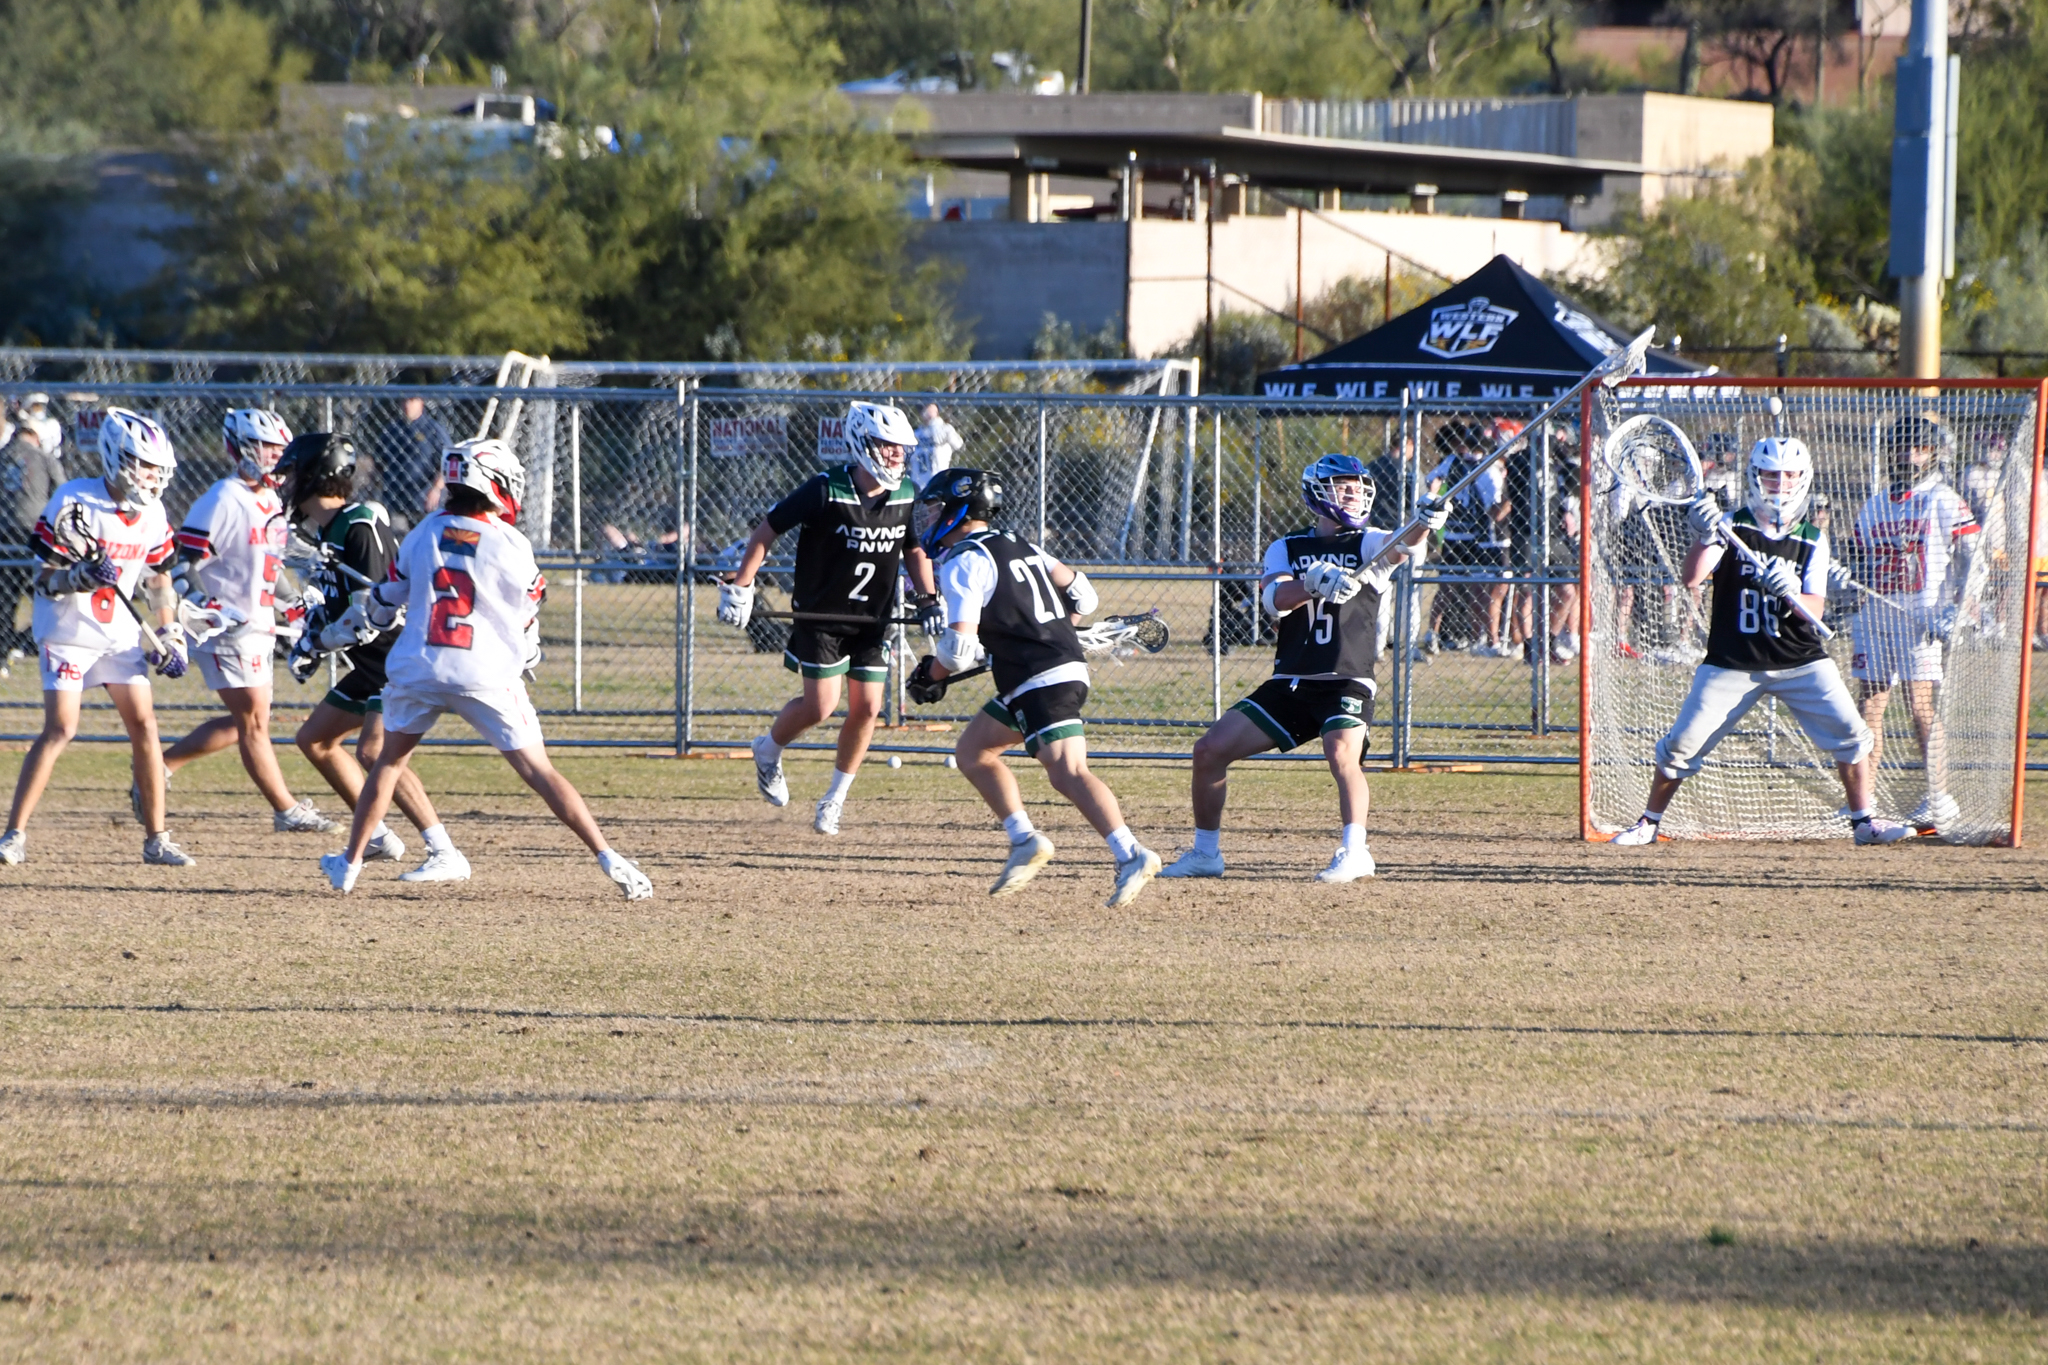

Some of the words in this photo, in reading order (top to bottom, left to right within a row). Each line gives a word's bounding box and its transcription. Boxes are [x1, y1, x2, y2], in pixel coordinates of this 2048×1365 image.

[1430, 321, 1504, 342] WLF
[712, 419, 784, 437] NATIONAL
[846, 538, 895, 553] PNW
[848, 562, 876, 602] 2
[1009, 555, 1066, 625] 27
[426, 566, 476, 651] 2
